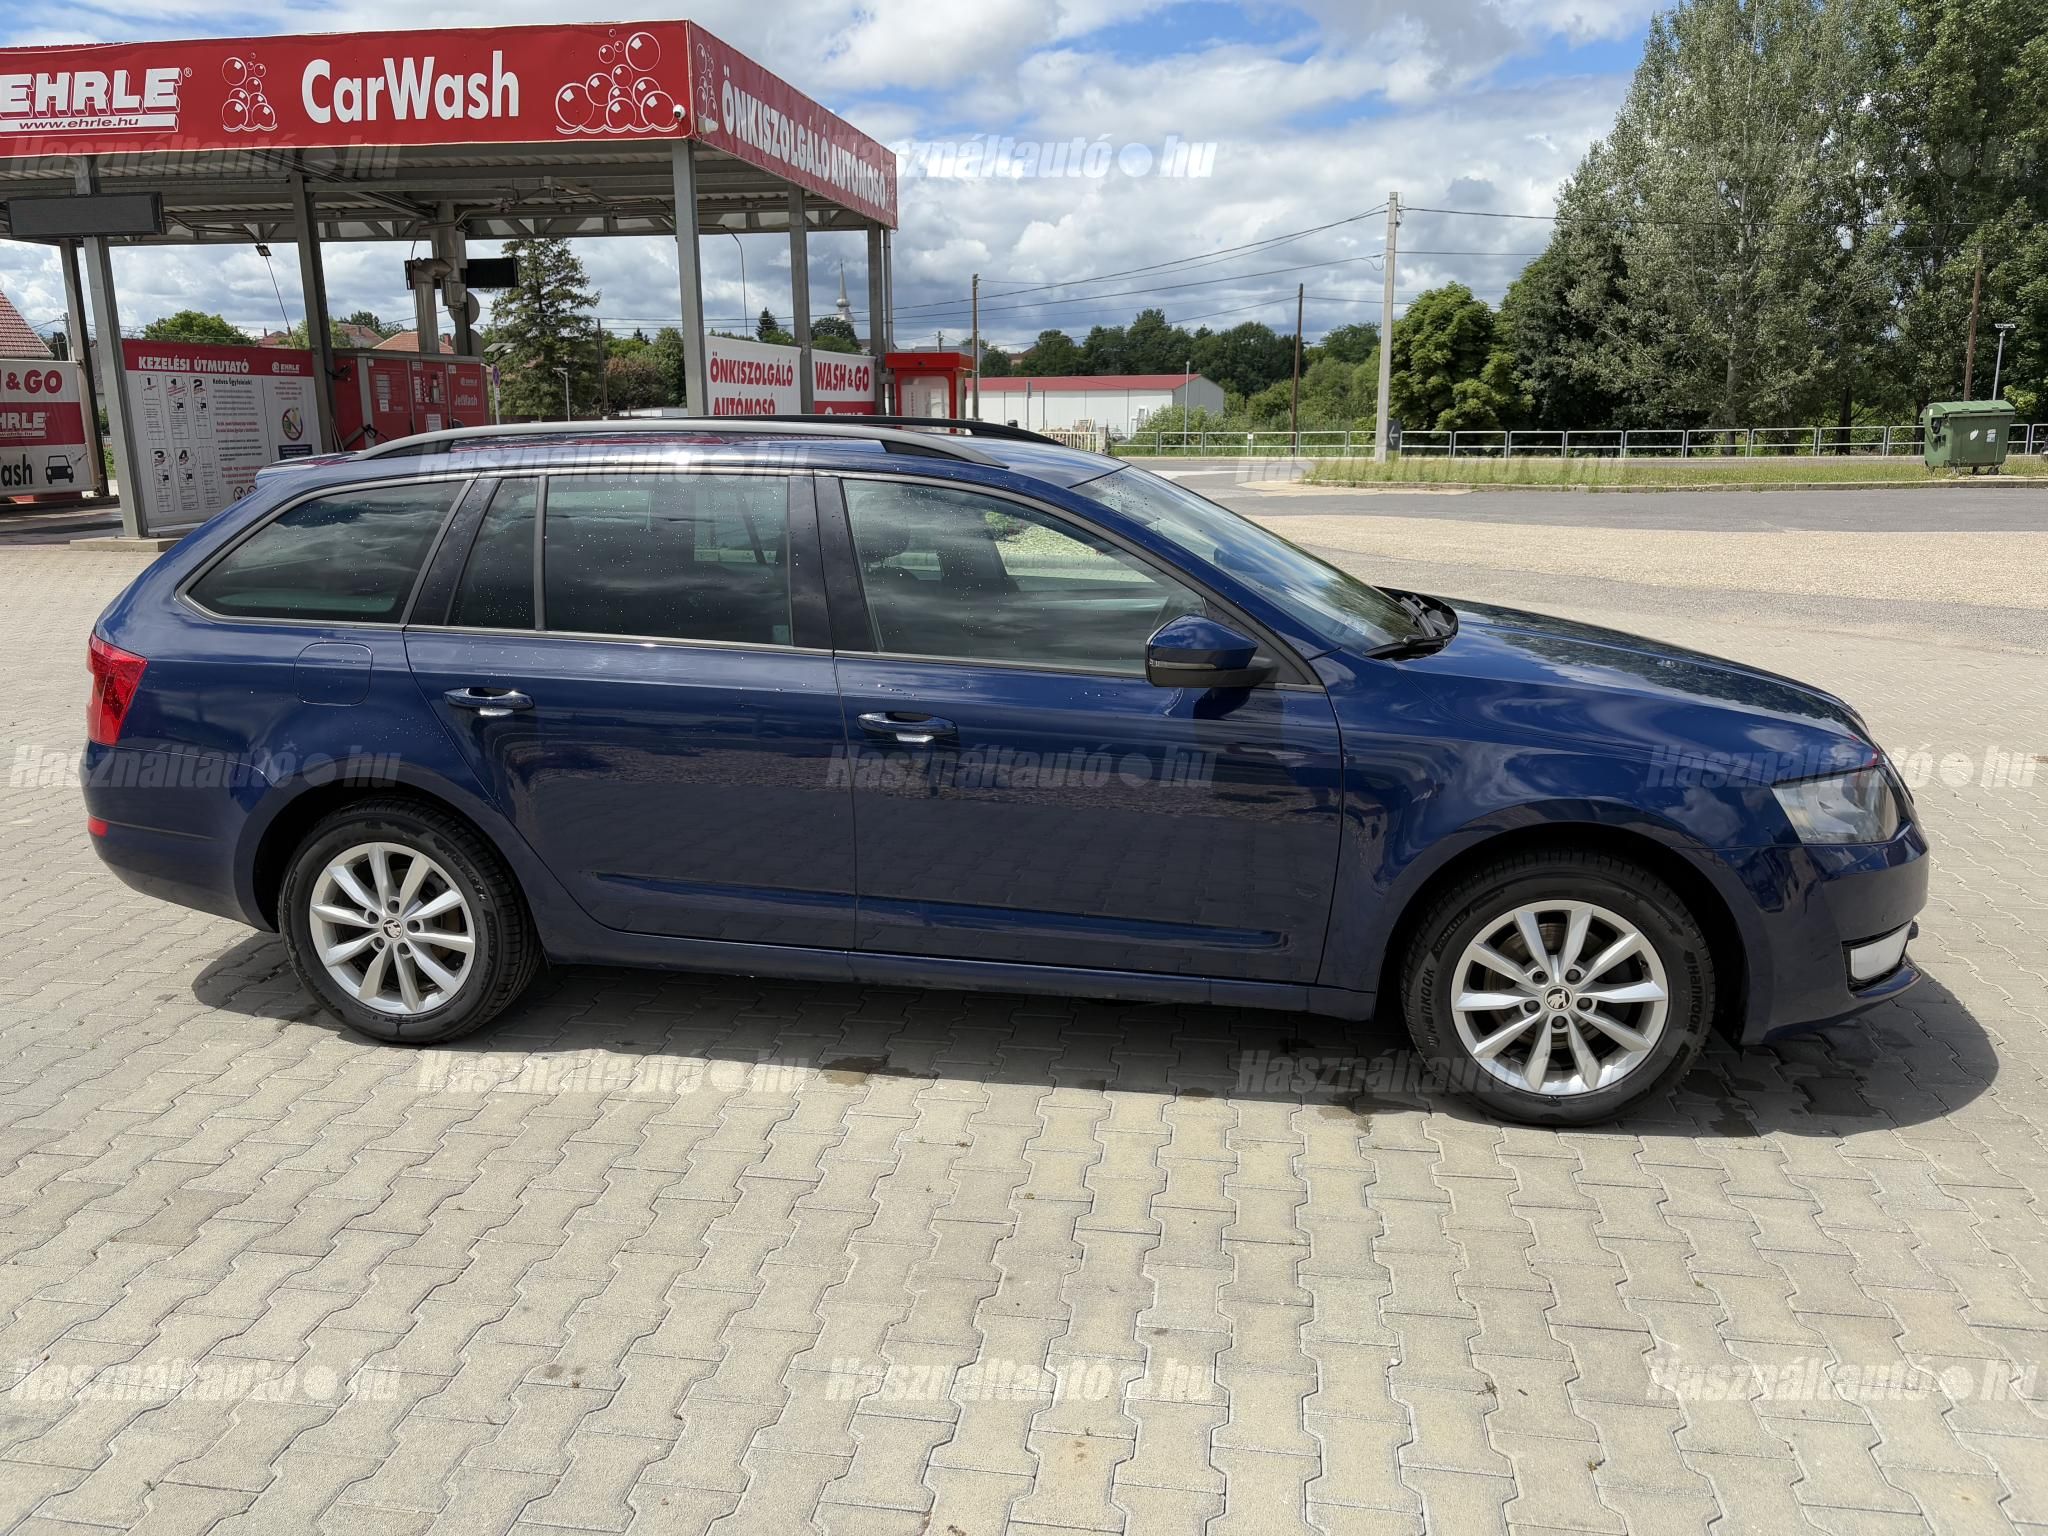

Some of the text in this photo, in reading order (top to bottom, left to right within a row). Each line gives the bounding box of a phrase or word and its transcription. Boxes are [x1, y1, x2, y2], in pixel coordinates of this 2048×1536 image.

[302, 50, 519, 124] CarWash
[19, 117, 139, 130] www.ehrle.hu
[722, 65, 887, 210] ÖNKISZOLGÁLÓ AUTÓMOSÓ
[138, 355, 249, 373] KEZELÉSI ÚTMUTATÓ
[709, 352, 794, 387] ÖNKISZOLGÁLÓ
[815, 361, 870, 392] WASH & GO
[6, 372, 21, 391] &
[24, 369, 63, 394] GO
[713, 391, 776, 415] AUTÓMOSÓ
[0, 412, 46, 430] HRLE
[0, 454, 33, 487] ash
